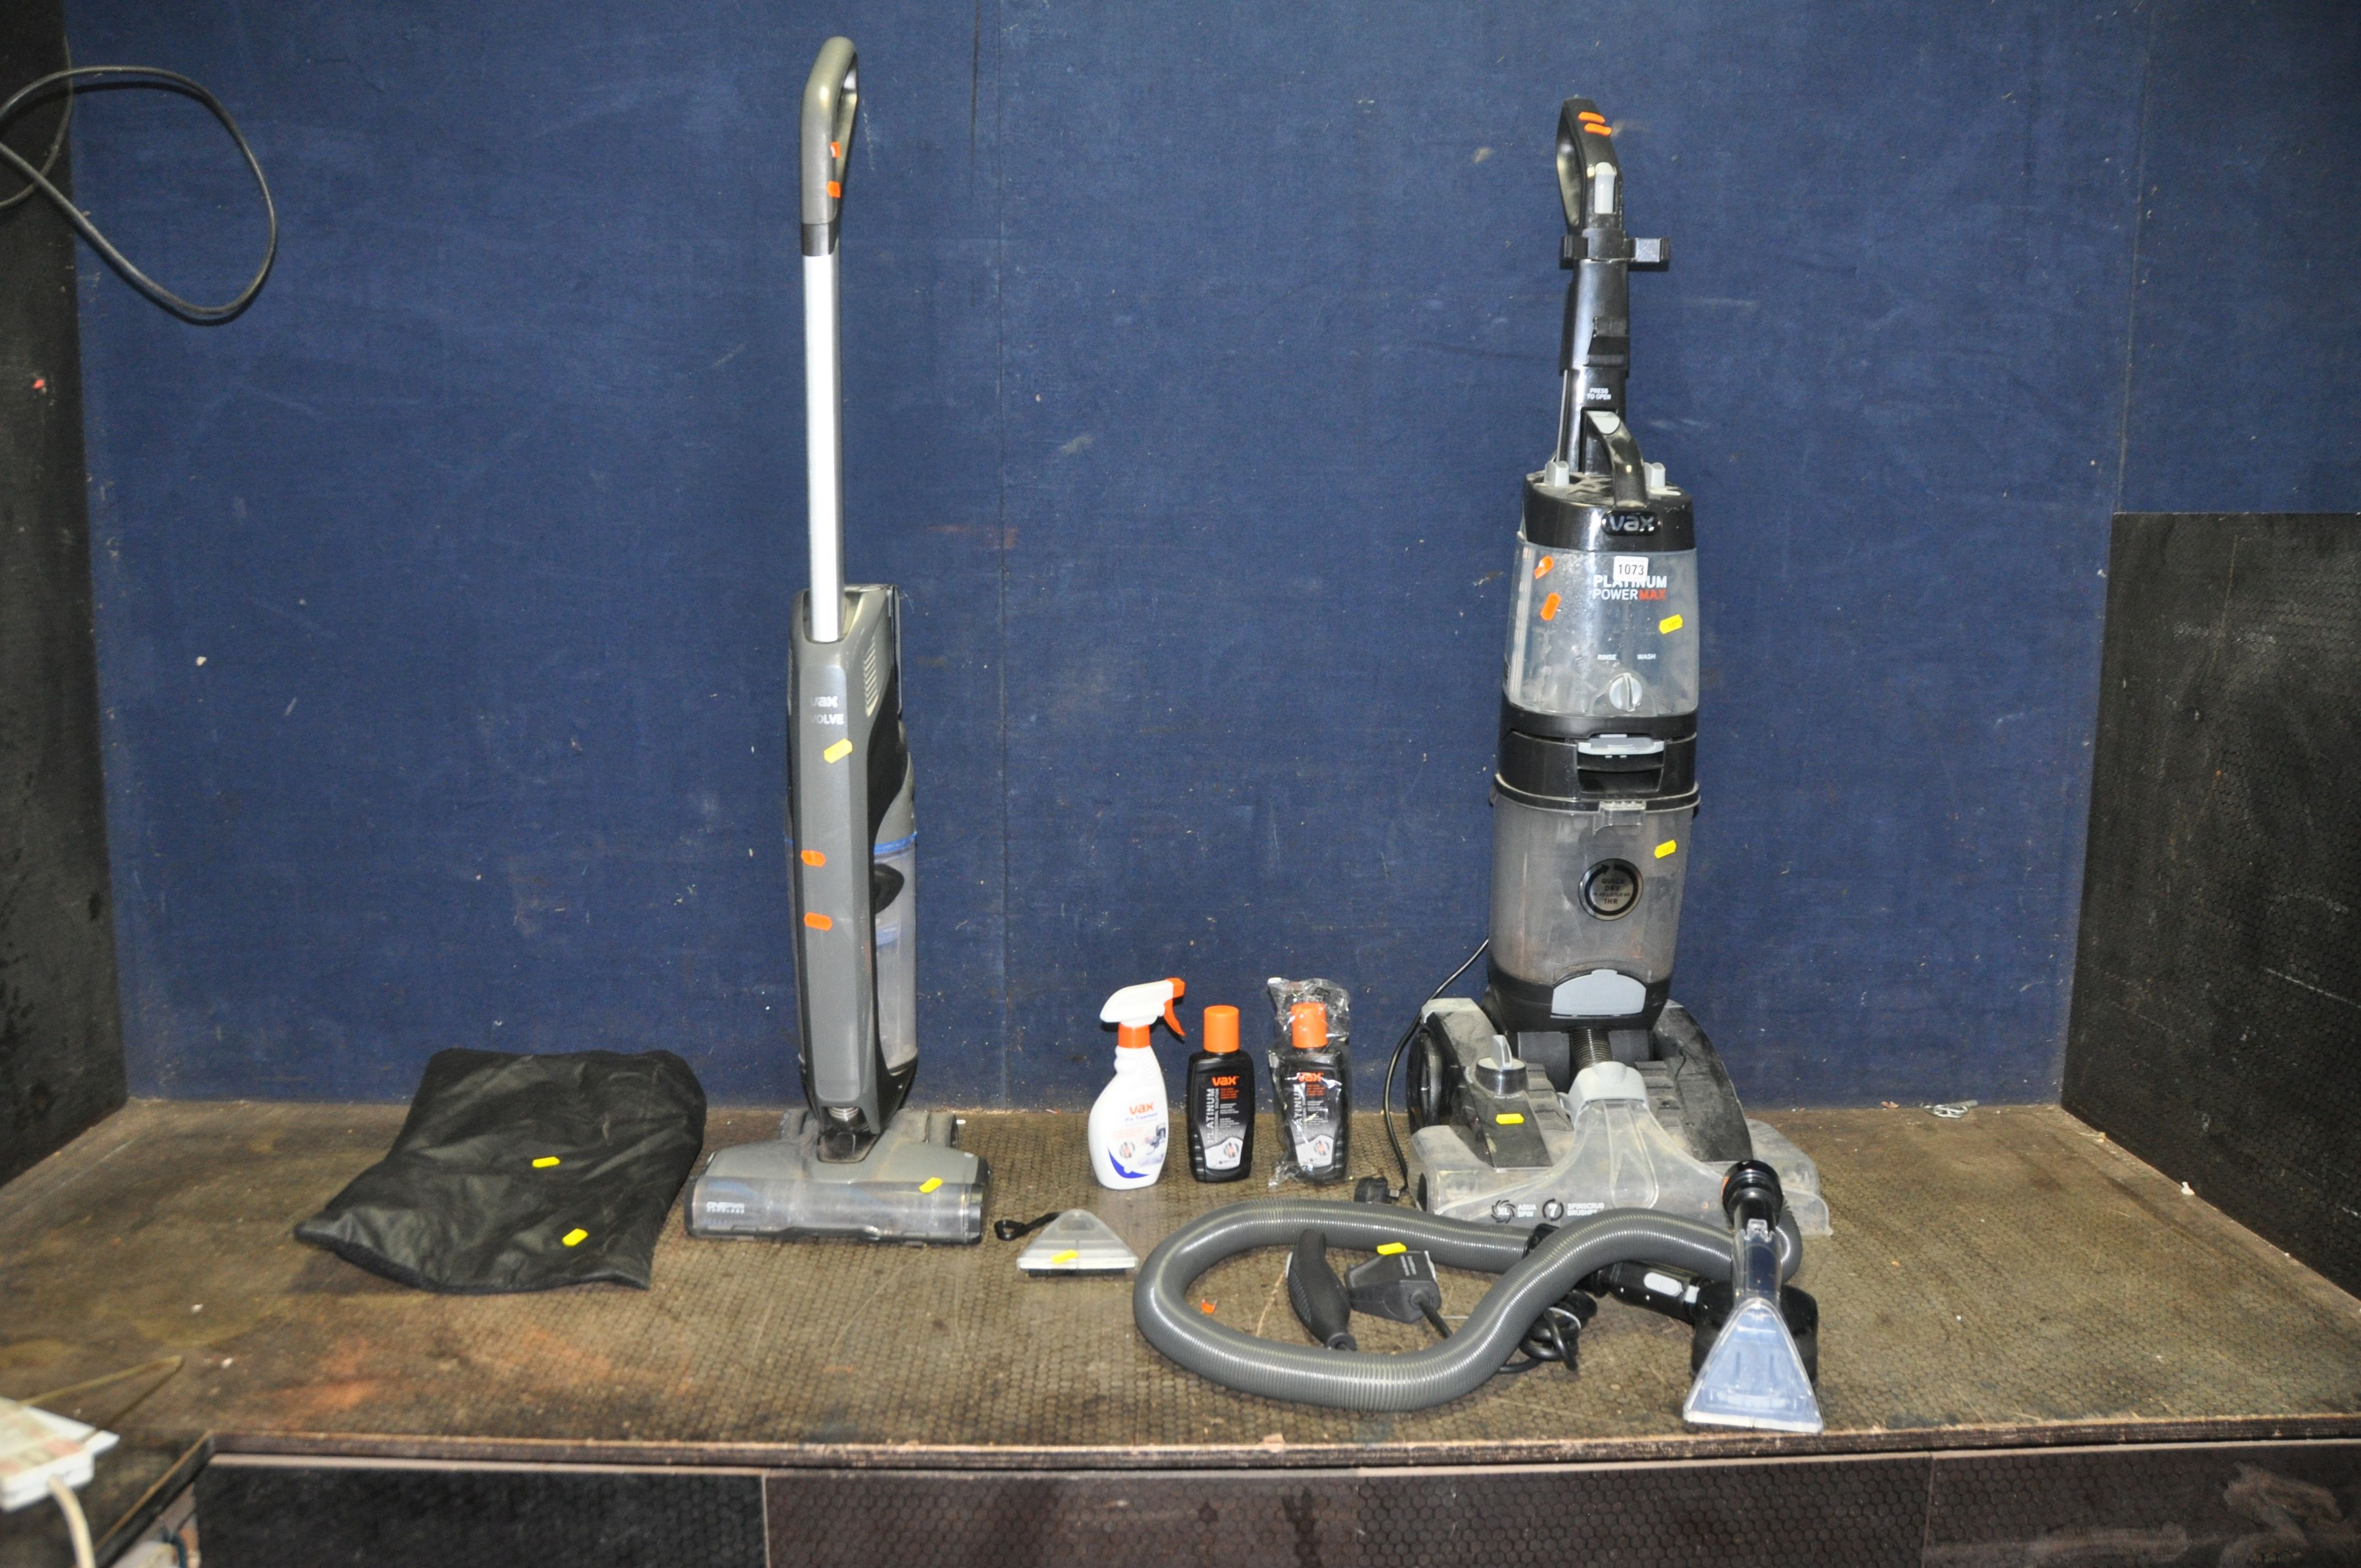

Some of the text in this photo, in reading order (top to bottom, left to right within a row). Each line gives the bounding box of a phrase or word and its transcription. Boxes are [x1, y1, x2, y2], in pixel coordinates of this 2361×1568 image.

[1609, 515, 1655, 532] vax
[1618, 564, 1645, 575] 1073
[1212, 1076, 1237, 1086] vax
[1129, 1102, 1154, 1115] vax
[1206, 1088, 1215, 1143] PLATINUM
